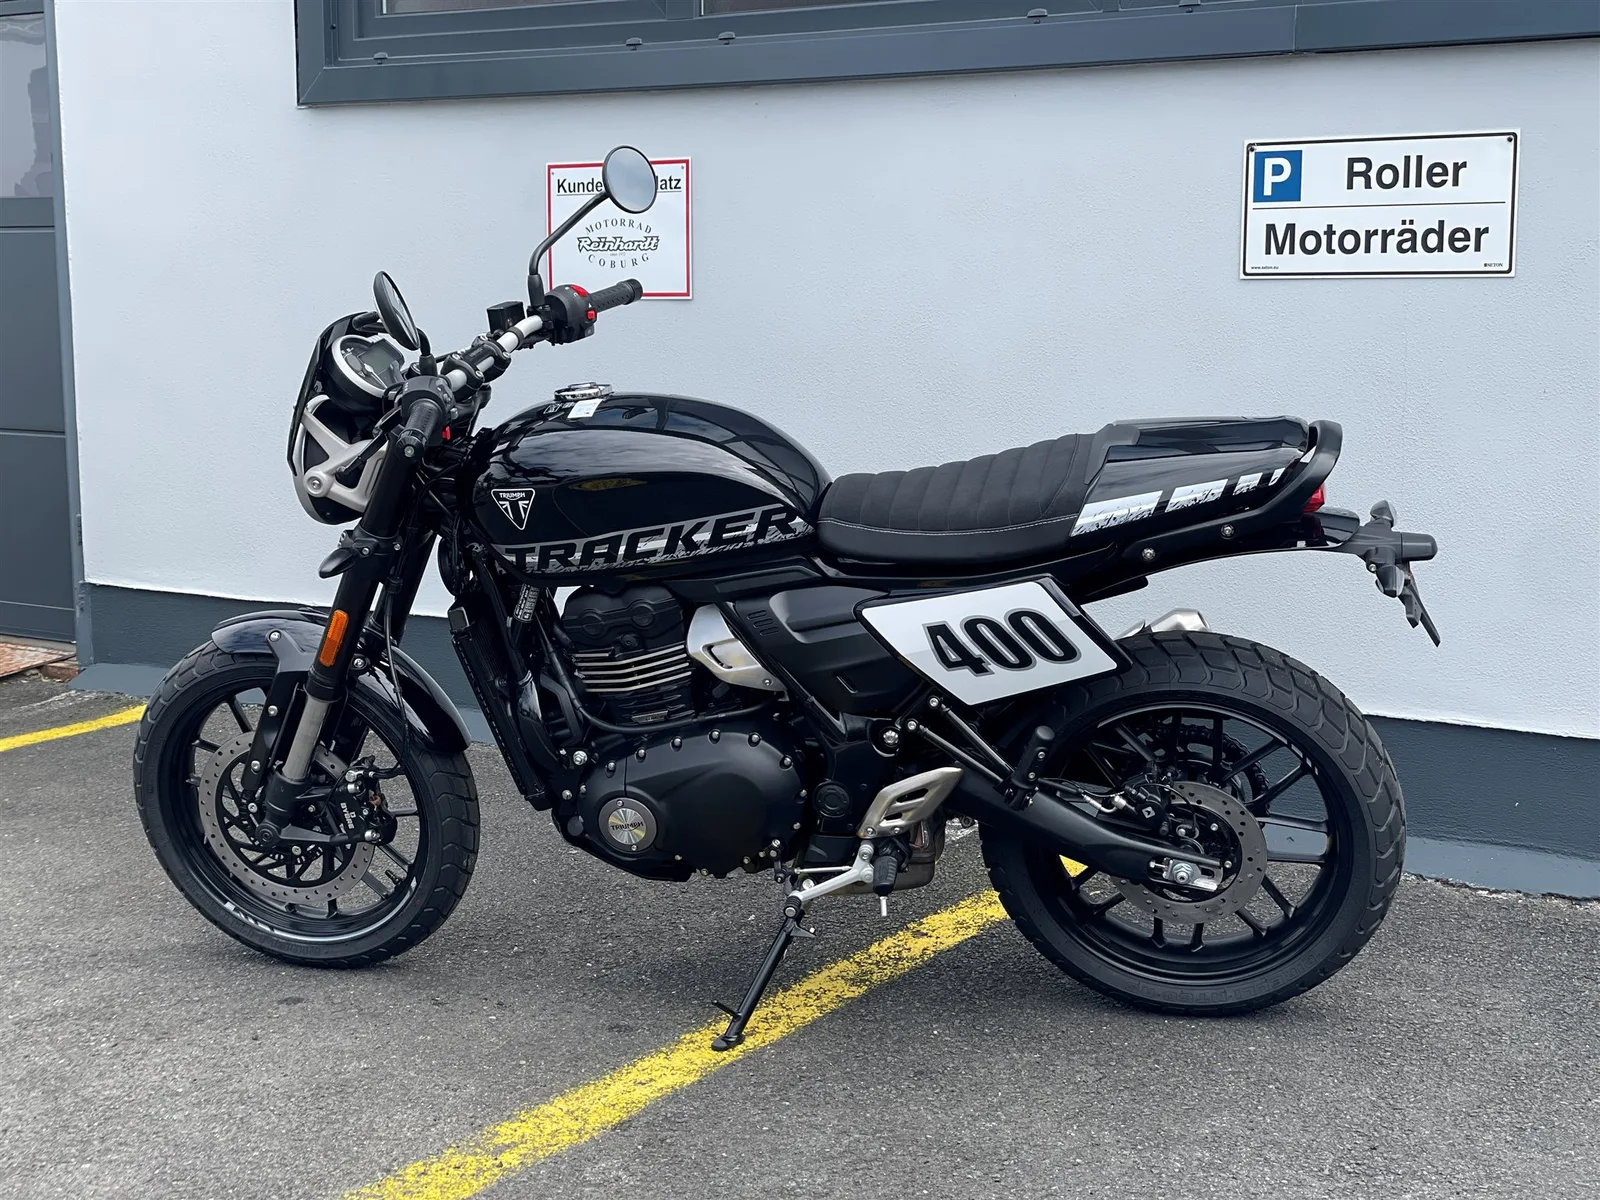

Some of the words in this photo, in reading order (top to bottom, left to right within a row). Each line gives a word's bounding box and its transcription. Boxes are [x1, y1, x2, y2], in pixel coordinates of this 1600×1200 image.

[1263, 157, 1292, 197] P
[1346, 154, 1468, 191] Roller
[585, 218, 652, 235] MOTORRAD
[576, 235, 660, 253] Reinhardt
[1264, 219, 1490, 256] Motorräder
[587, 253, 650, 269] COBURG
[498, 491, 526, 500] TRIUMPH
[503, 505, 799, 572] TRACKER
[922, 607, 1083, 677] 400
[610, 820, 645, 831] TRIUMPH
